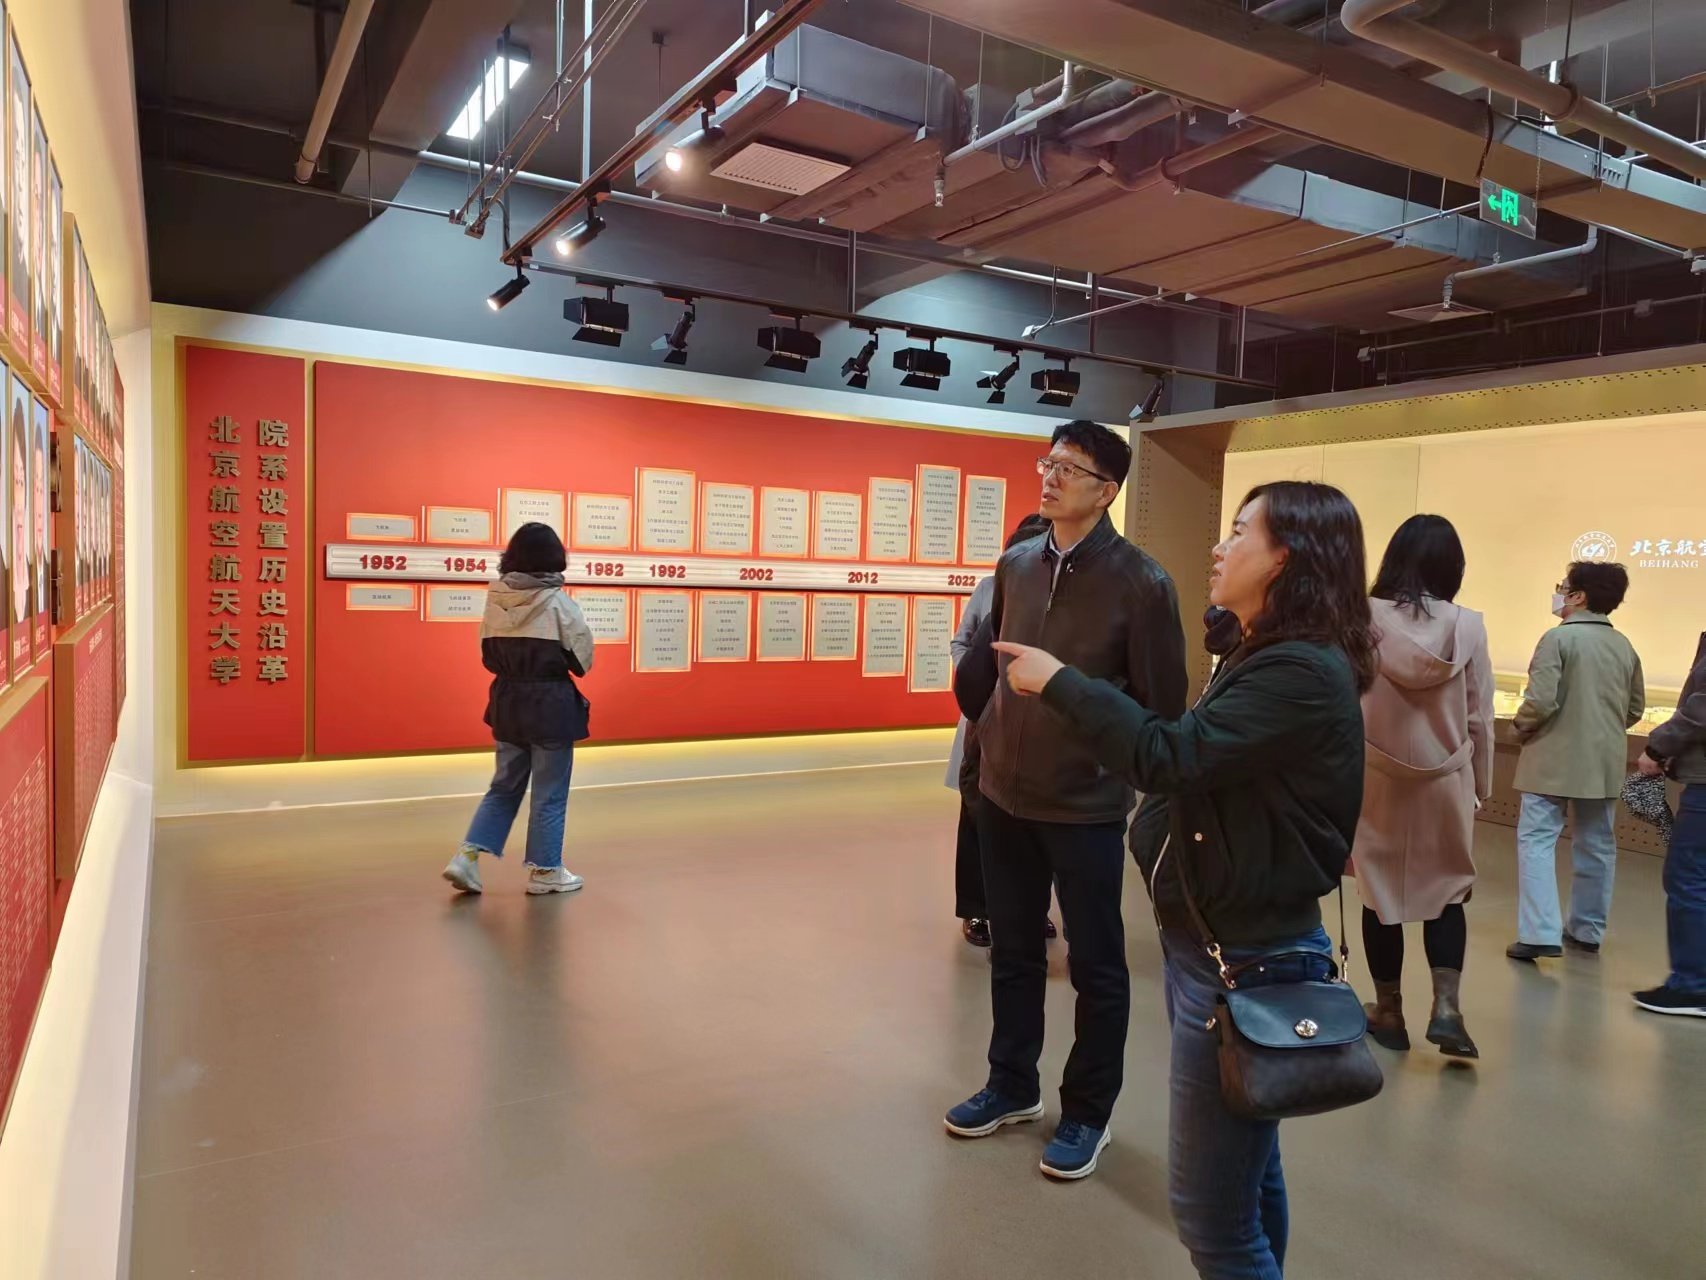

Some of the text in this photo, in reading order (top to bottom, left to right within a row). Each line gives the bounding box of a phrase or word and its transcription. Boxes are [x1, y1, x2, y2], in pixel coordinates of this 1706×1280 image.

[209, 415, 241, 684] 北京航空航天大学
[257, 418, 290, 683] 院系设置历史沿革
[359, 554, 407, 571] 1952
[443, 557, 487, 573] 1954
[585, 562, 624, 577] 1982
[1639, 559, 1699, 569] BEIHANG
[649, 564, 686, 578] 1992
[739, 567, 774, 581] 2002
[847, 571, 879, 584] 2012
[948, 574, 976, 587] 2022
